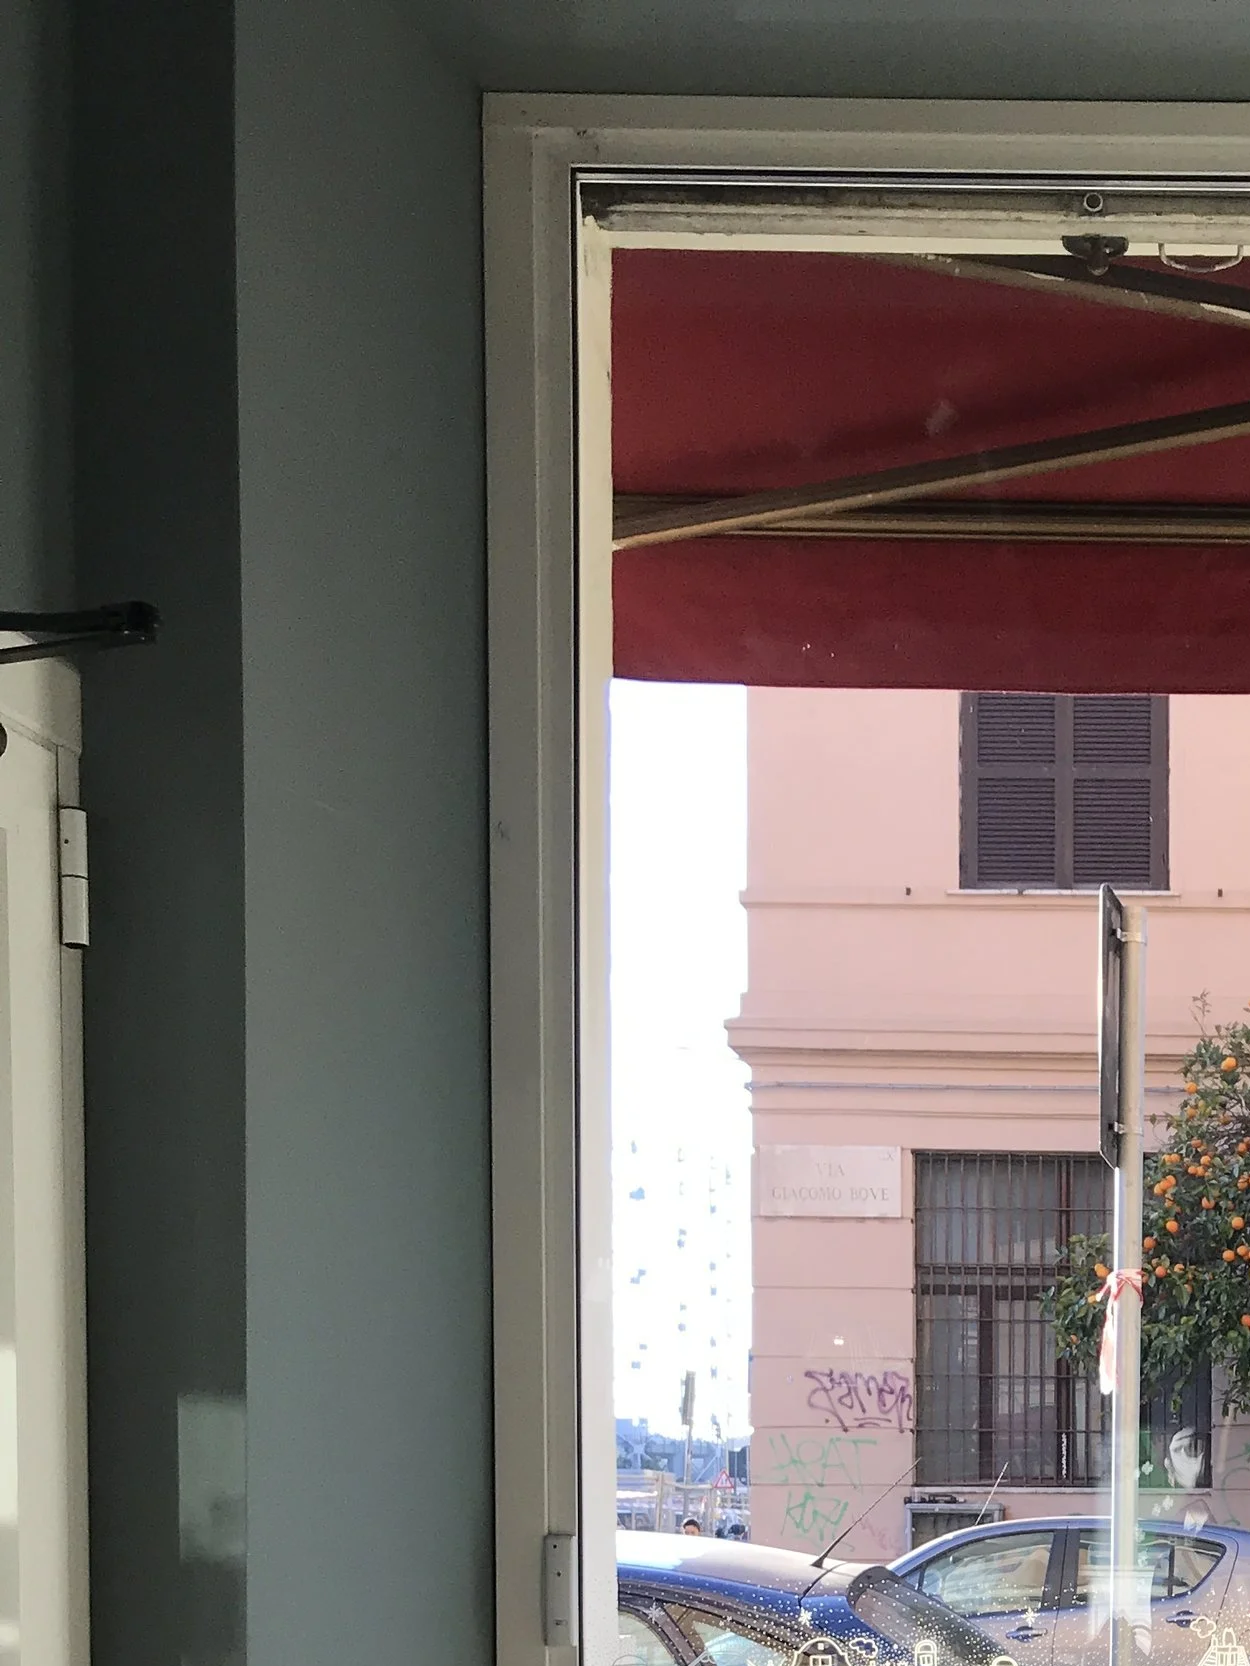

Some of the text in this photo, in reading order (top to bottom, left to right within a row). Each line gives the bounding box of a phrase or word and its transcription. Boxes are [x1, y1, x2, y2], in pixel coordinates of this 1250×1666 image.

[815, 1163, 846, 1177] VIA
[771, 1187, 890, 1201] GIACOMO BOVE
